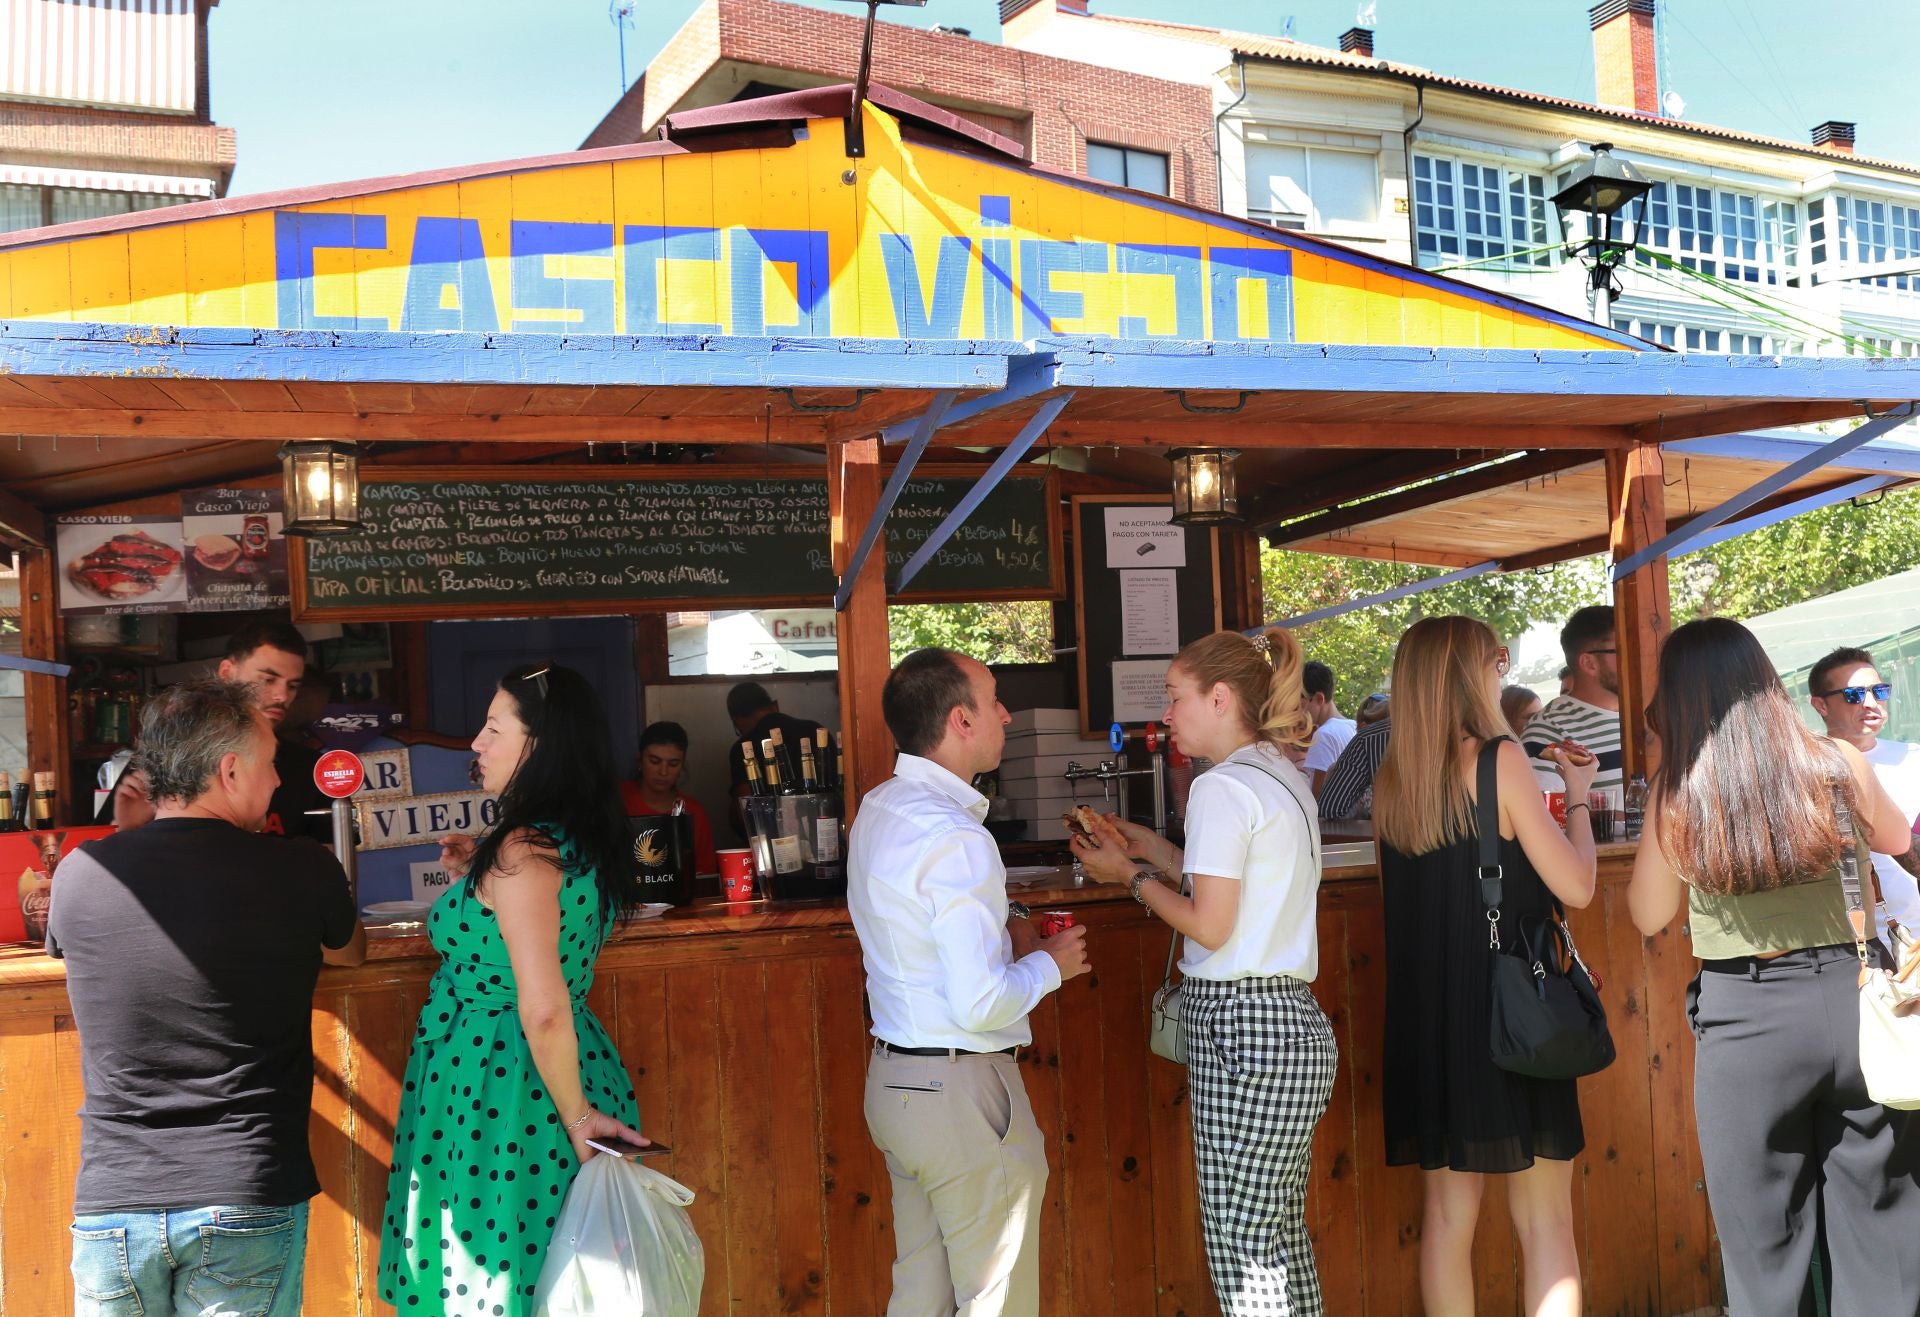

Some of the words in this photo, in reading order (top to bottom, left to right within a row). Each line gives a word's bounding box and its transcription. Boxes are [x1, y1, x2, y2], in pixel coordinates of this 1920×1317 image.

[275, 210, 830, 336] CASCO
[217, 488, 242, 499] Bar
[432, 483, 491, 498] CHAPATA
[501, 484, 552, 496] TOMATE
[553, 484, 616, 496] NATURAL
[626, 483, 690, 496] PIMIENTOS
[693, 484, 737, 496] ASADOS
[195, 502, 232, 513] Casco
[236, 499, 270, 514] Viejo
[387, 500, 446, 518] CHAPATA
[458, 499, 501, 515] FILETE
[597, 498, 609, 509] A
[614, 499, 630, 509] LA
[634, 497, 697, 509] PLANCHA
[707, 496, 776, 511] PIMIENTOS
[58, 515, 97, 524] CASCO
[98, 515, 133, 524] VIEJO
[390, 516, 451, 533] CHAPATA
[544, 513, 582, 525] POLLO
[587, 513, 595, 522] A
[600, 513, 614, 522] LA
[617, 508, 672, 523] PLANCHA
[676, 509, 697, 522] CON
[755, 508, 800, 523] BACON
[1119, 520, 1130, 528] NO
[456, 530, 531, 546] BOCADILLO
[542, 529, 569, 542] DOS
[571, 524, 644, 540] PANCETAS
[649, 526, 665, 538] AL
[671, 523, 715, 537] AJILLO
[723, 522, 777, 536] TOMATE
[307, 555, 403, 573] EMPANADA
[497, 545, 548, 564] BONITO
[560, 546, 601, 559] HUEVO
[614, 542, 683, 556] PIMIENTOS
[695, 540, 749, 556] TOMATE
[936, 547, 985, 568] BEBIDA
[207, 582, 252, 596] Chapata
[254, 580, 268, 591] de
[308, 575, 350, 598] TAPA
[438, 568, 515, 592] BOCADILLO
[536, 567, 598, 587] CHORIZO
[601, 574, 624, 586] CON
[625, 564, 666, 585] SIDRA
[229, 592, 242, 604] de
[105, 607, 122, 616] Mar
[123, 605, 134, 614] de
[772, 618, 837, 639] Cafet
[323, 769, 355, 778] ESTRELLA
[645, 873, 675, 884] BLACK
